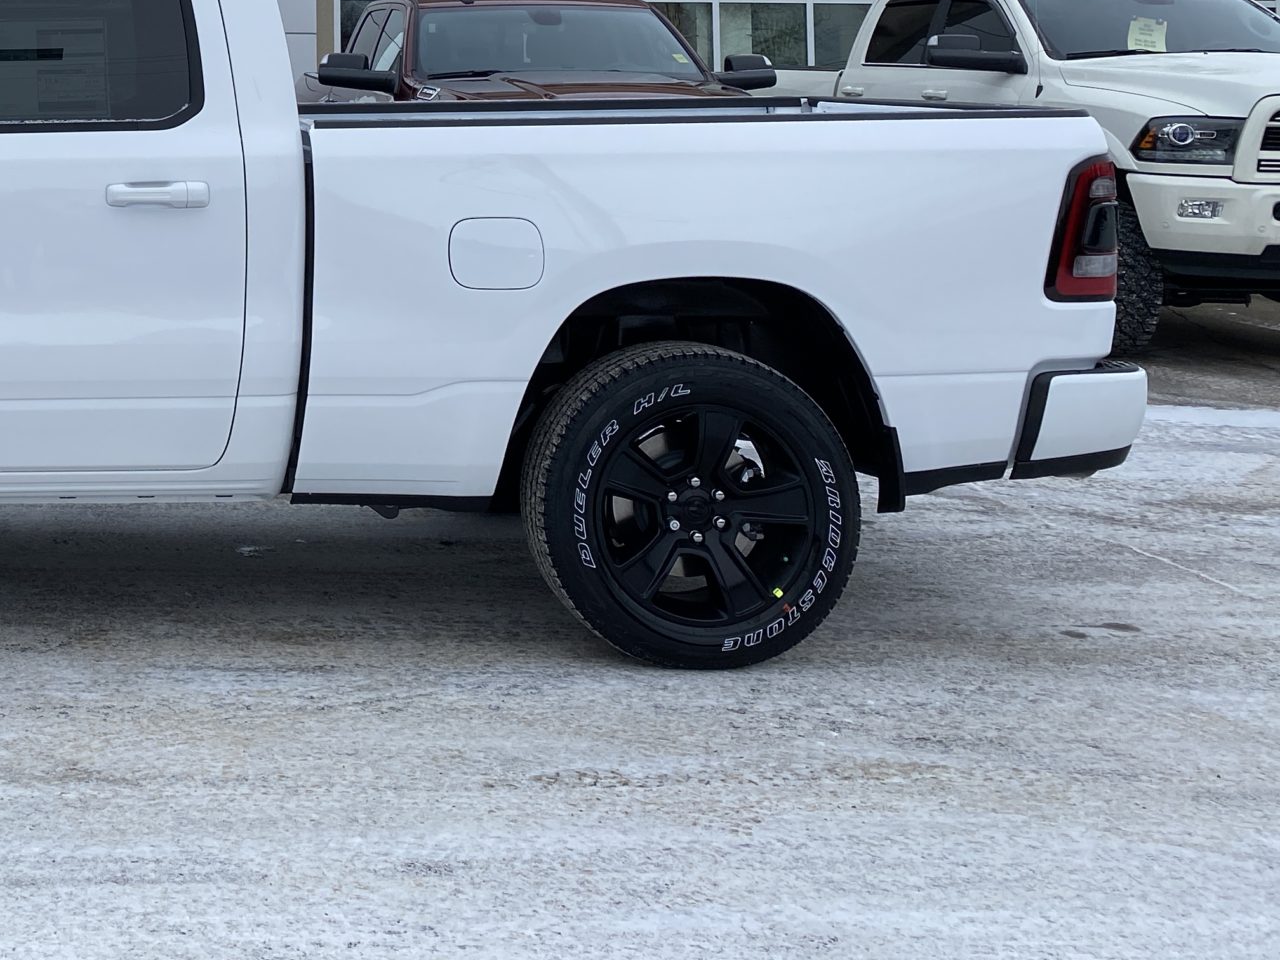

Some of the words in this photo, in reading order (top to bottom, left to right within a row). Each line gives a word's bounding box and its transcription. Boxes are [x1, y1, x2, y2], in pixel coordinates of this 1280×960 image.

[572, 419, 620, 569] DUELER
[633, 383, 691, 415] H/L
[721, 457, 843, 652] BRIDGESTONE
